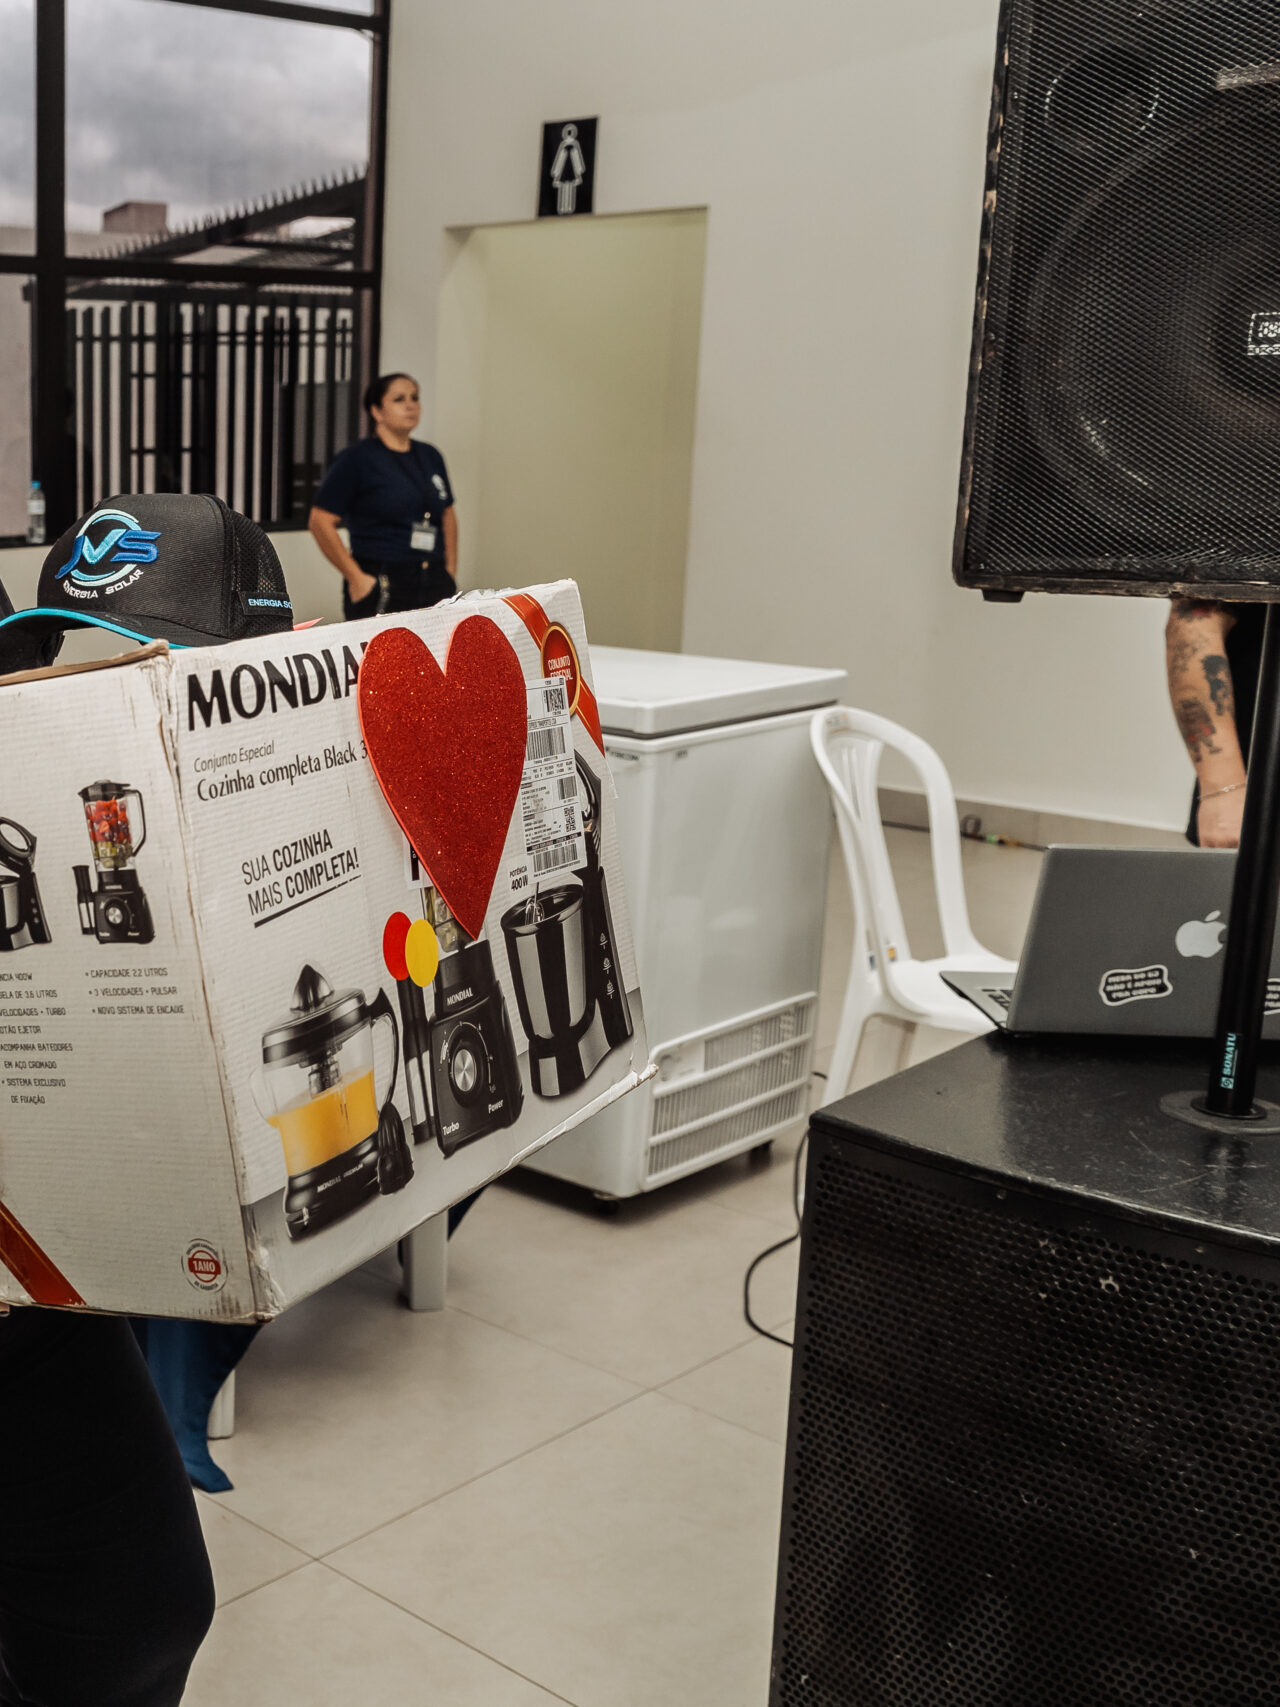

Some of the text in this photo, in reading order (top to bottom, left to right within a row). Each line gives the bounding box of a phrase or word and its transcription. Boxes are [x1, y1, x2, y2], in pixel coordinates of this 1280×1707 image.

[63, 569, 144, 599] ENERGIA SOLAR
[248, 599, 283, 607] ENERGIA
[194, 740, 275, 773] Conjunto Especial
[197, 769, 255, 802] Cozinha
[259, 754, 321, 786] completa
[323, 741, 357, 769] Black
[241, 828, 333, 886] SUA COZINHA
[248, 847, 360, 916] MAIS COMPLETA!
[446, 987, 473, 1006] MONDIAL
[488, 1099, 504, 1114] Power
[442, 1122, 460, 1136] Turbo
